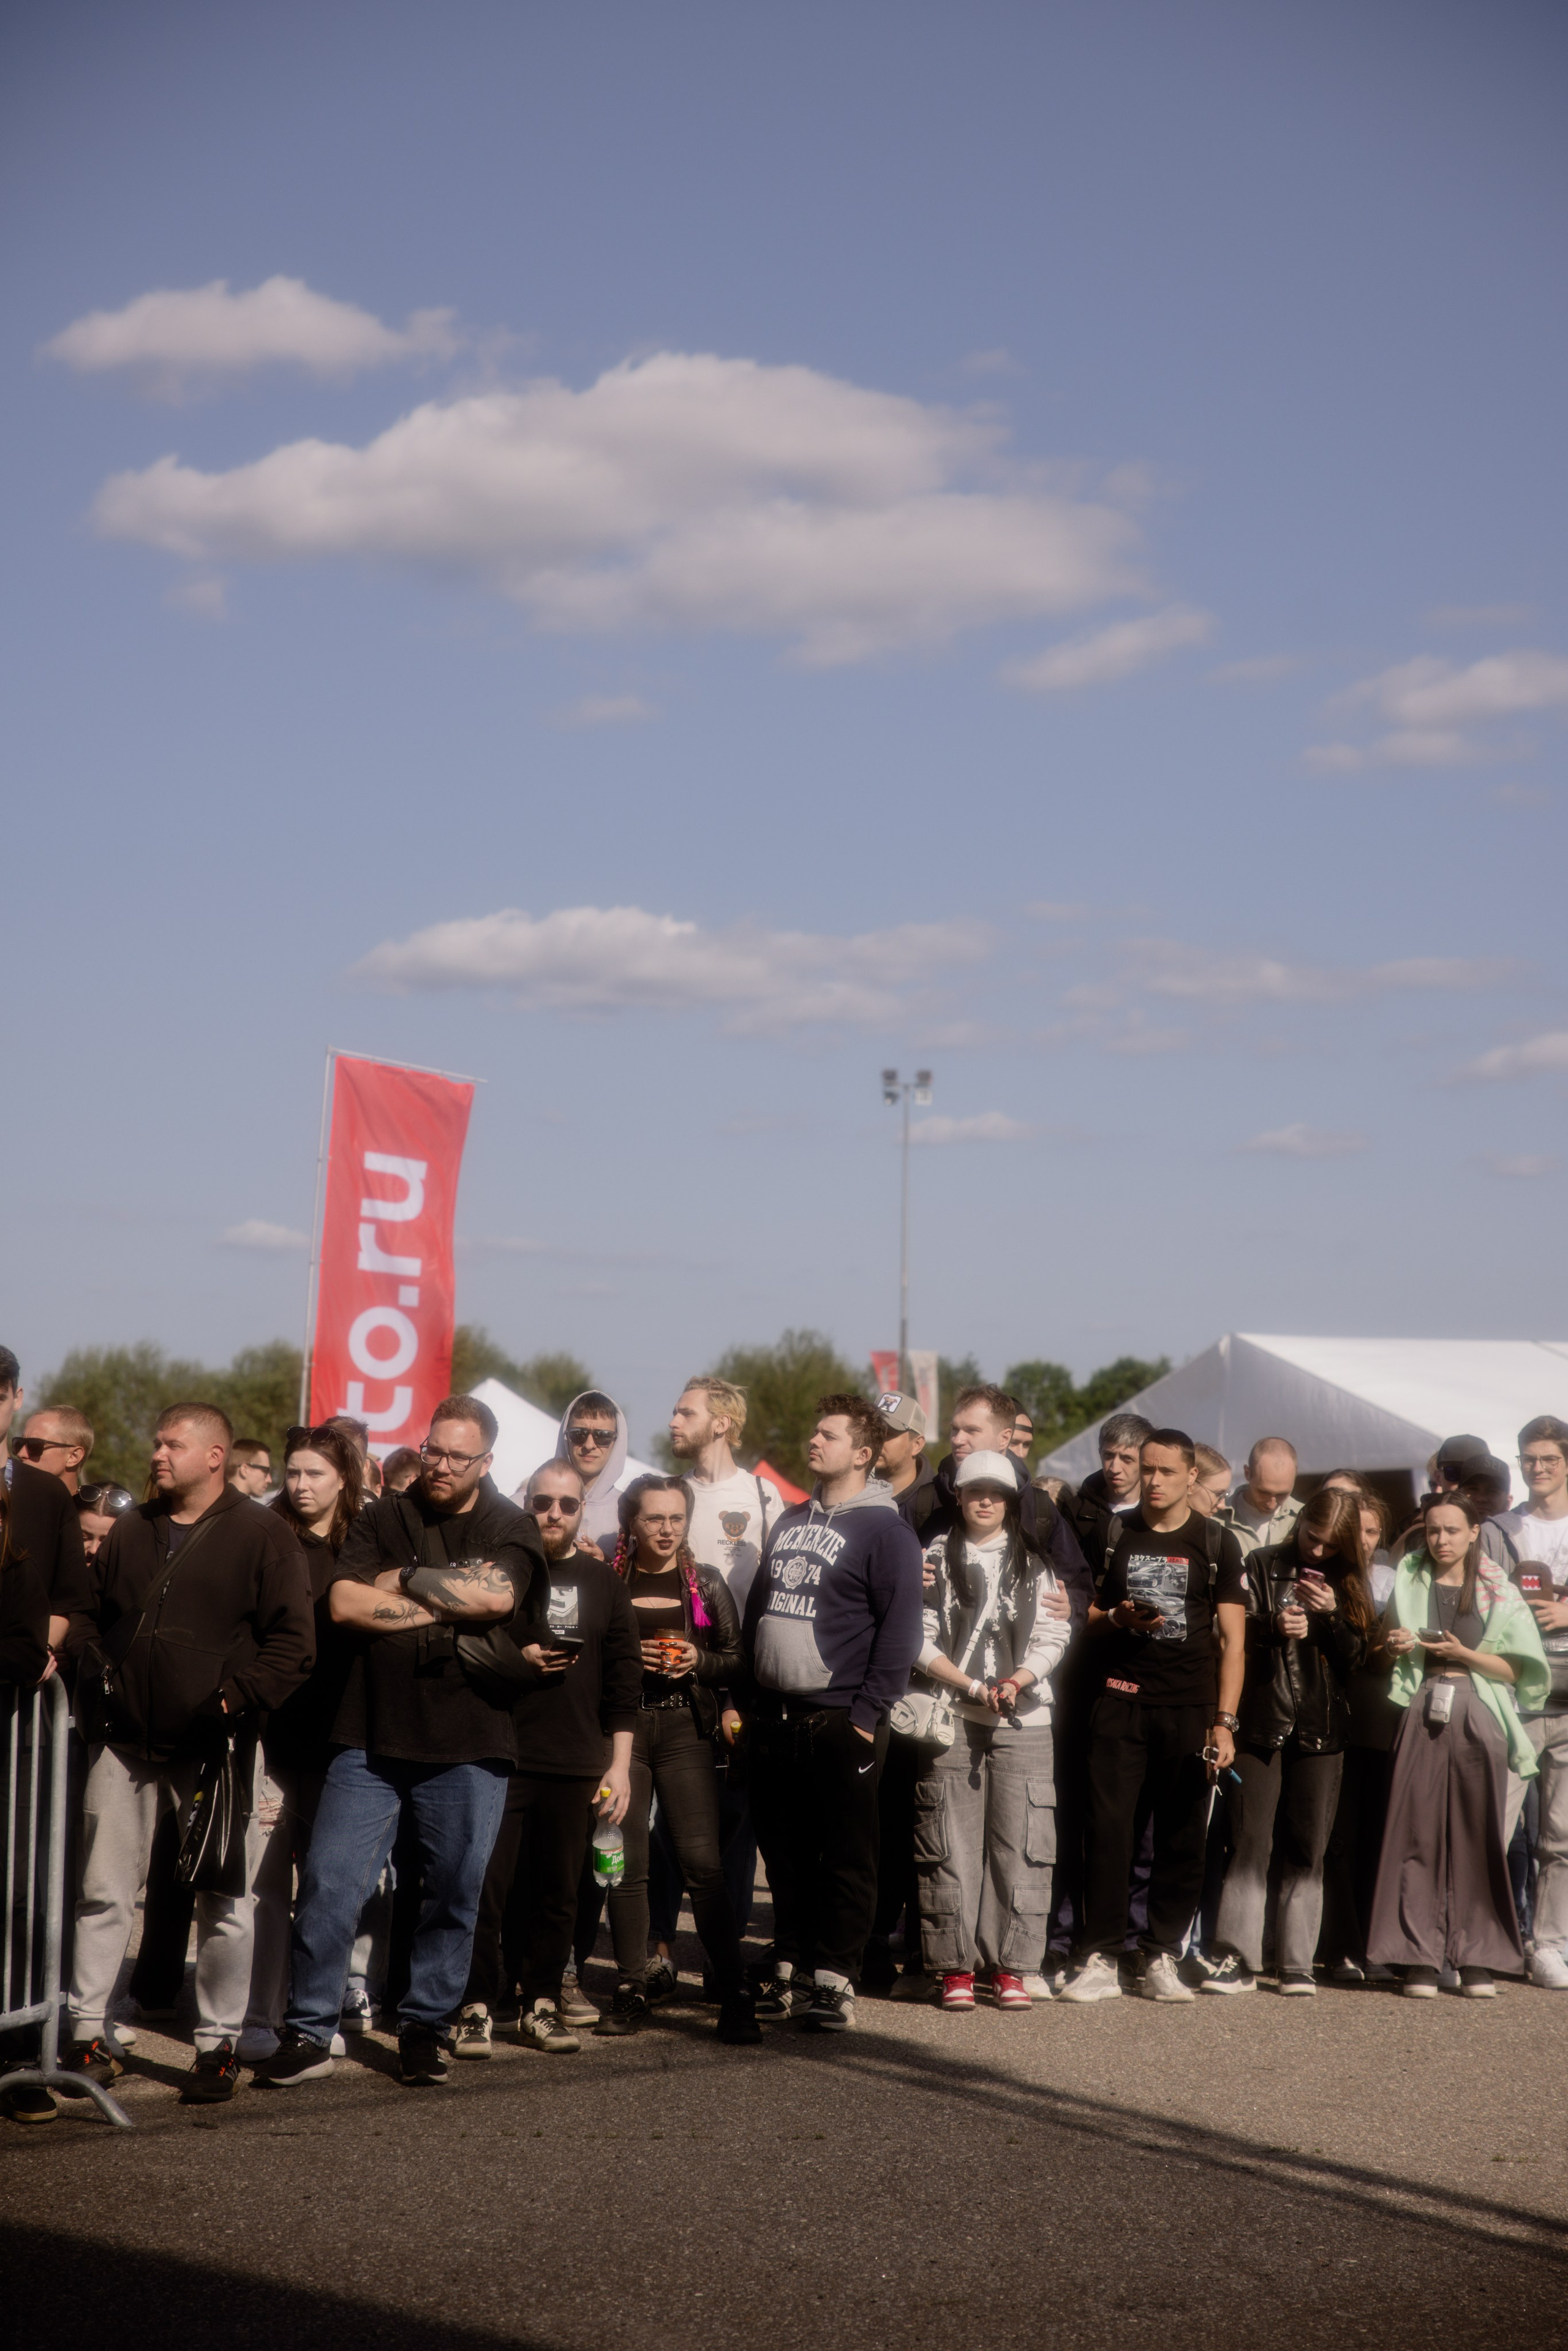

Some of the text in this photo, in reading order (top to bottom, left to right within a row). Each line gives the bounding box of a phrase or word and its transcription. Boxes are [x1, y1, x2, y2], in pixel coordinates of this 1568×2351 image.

[337, 1151, 427, 1462] to.ru
[770, 1524, 846, 1566] MCKENZIE
[771, 1559, 783, 1579] 19
[804, 1564, 822, 1585] 74
[1106, 1678, 1140, 1694] OSAKA RACING
